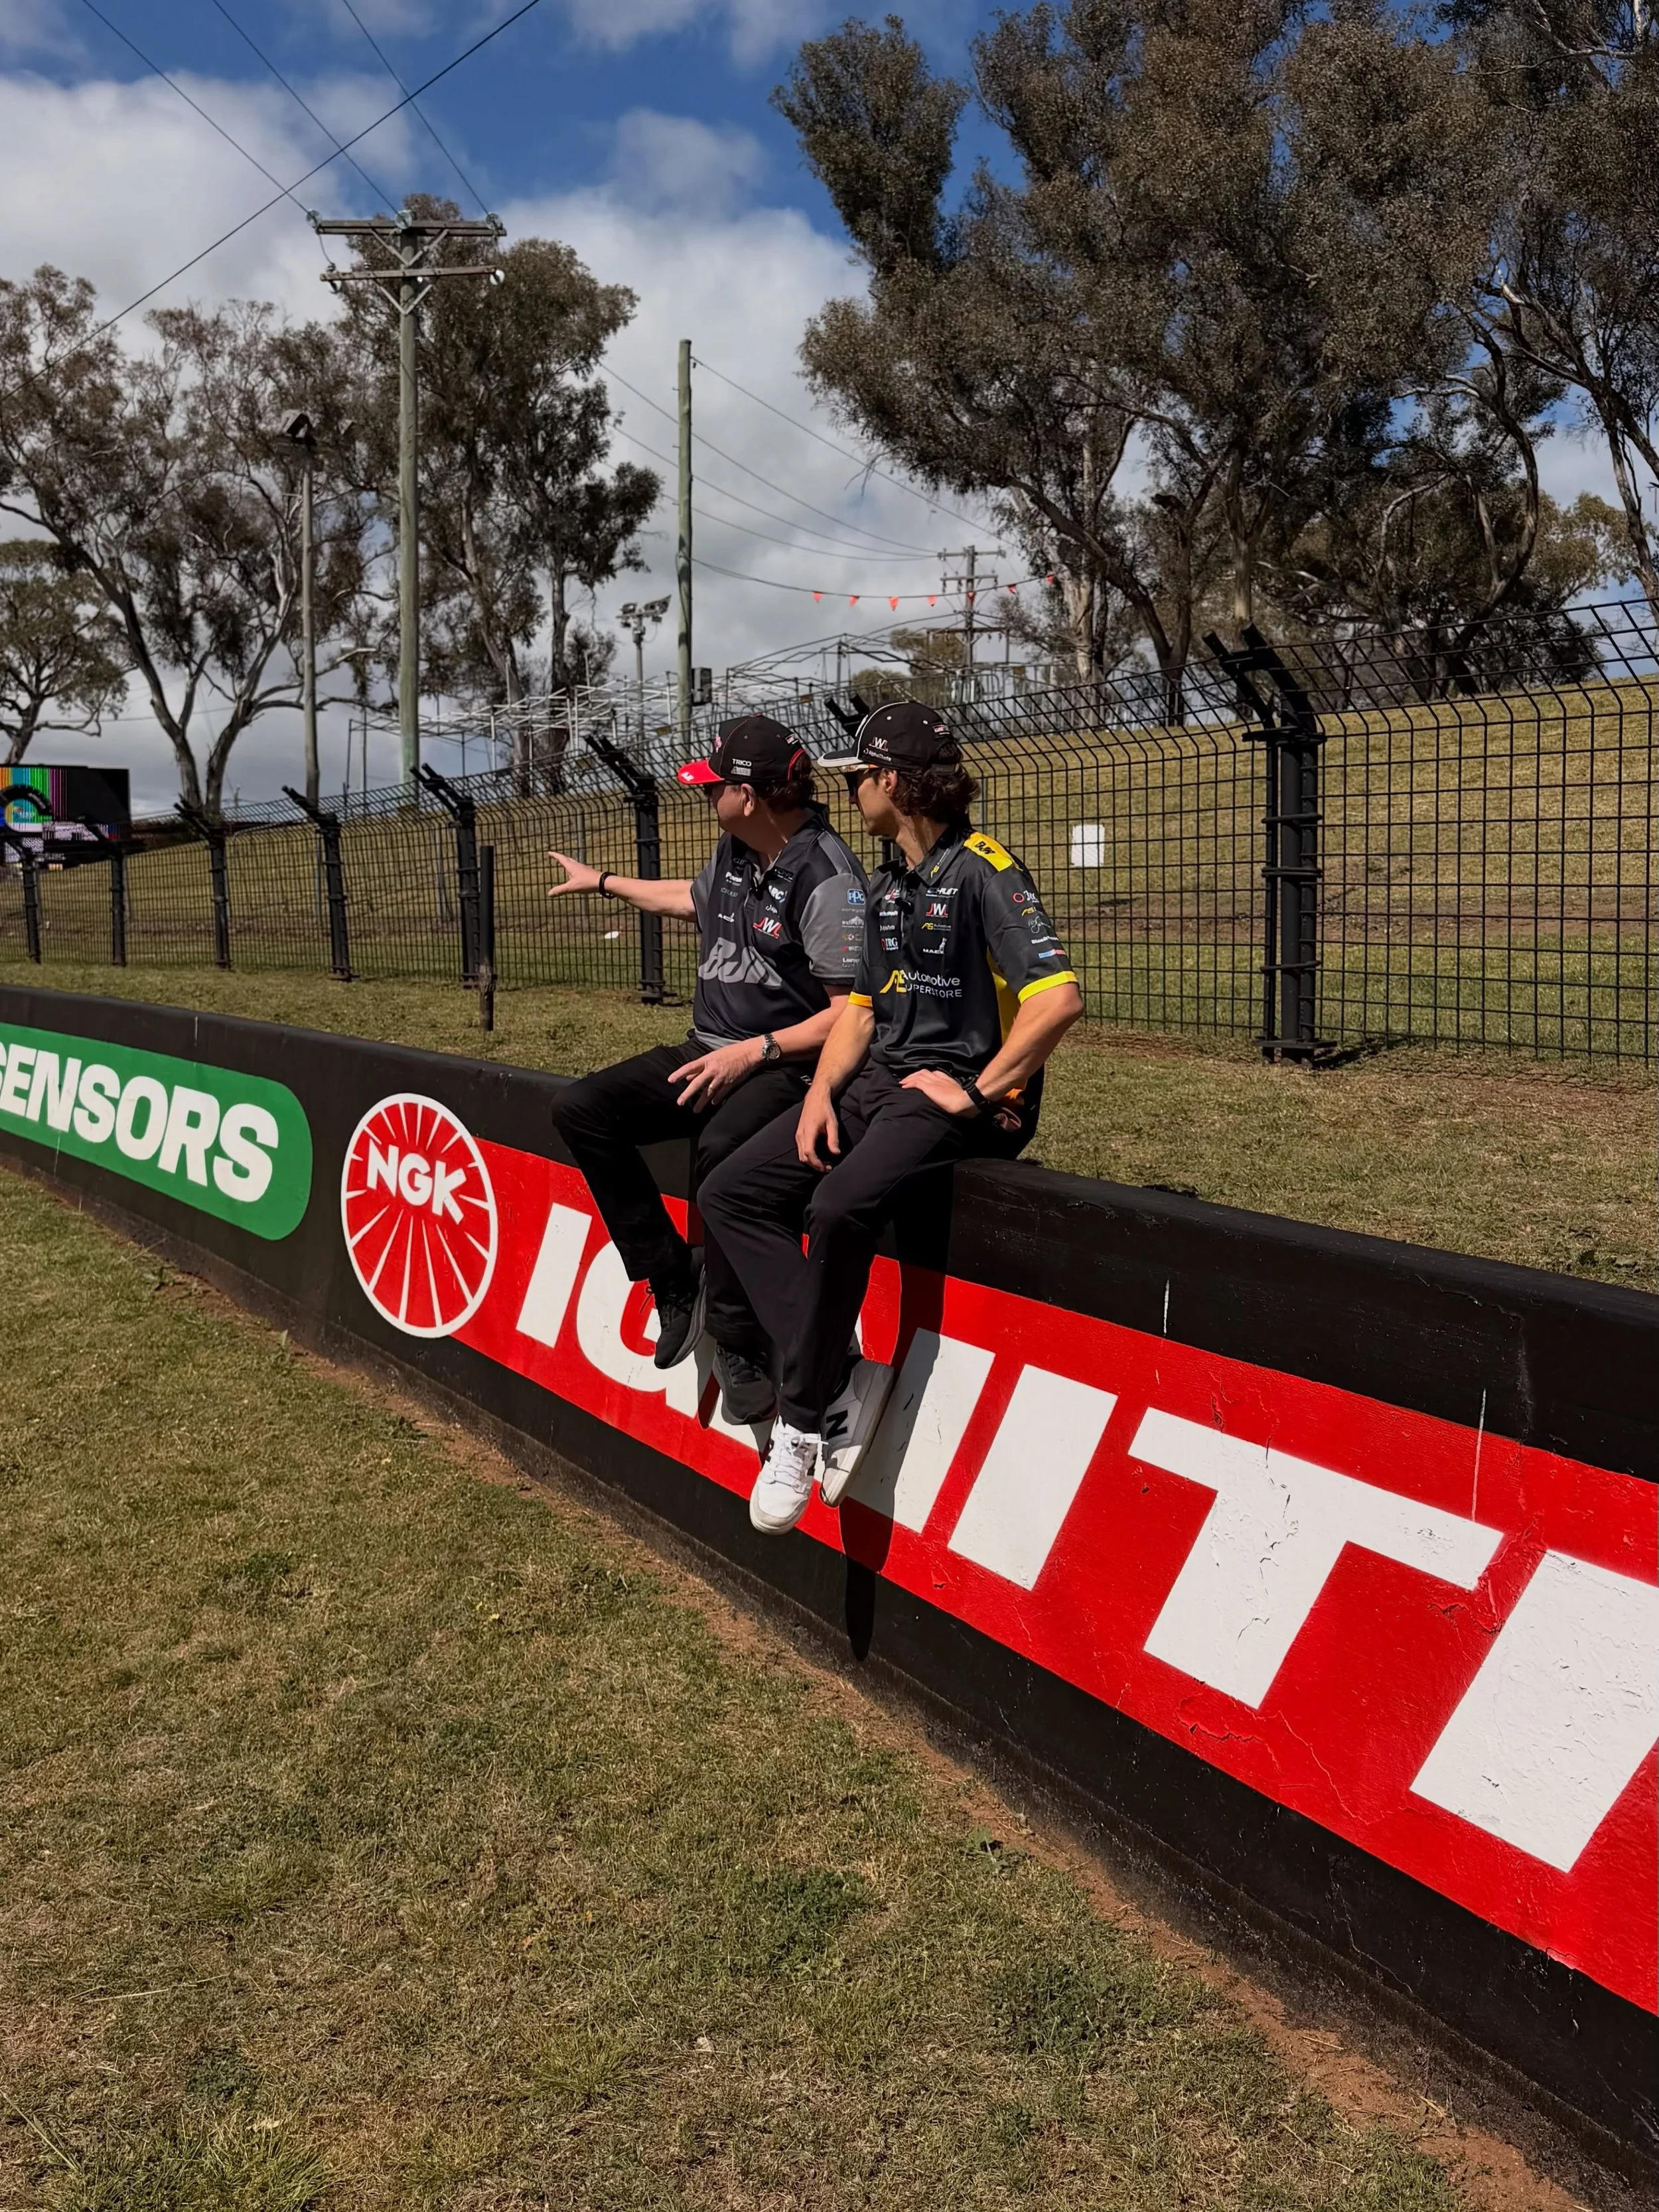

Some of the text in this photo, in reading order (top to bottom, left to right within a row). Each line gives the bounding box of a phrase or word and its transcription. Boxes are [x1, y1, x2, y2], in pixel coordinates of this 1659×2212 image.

[926, 903, 948, 916] JWL
[753, 917, 783, 936] JWL
[899, 970, 960, 987] Automotive
[905, 984, 962, 998] UPERSTORE
[0, 1040, 279, 1203] ENSORS
[366, 1139, 467, 1224] NGK
